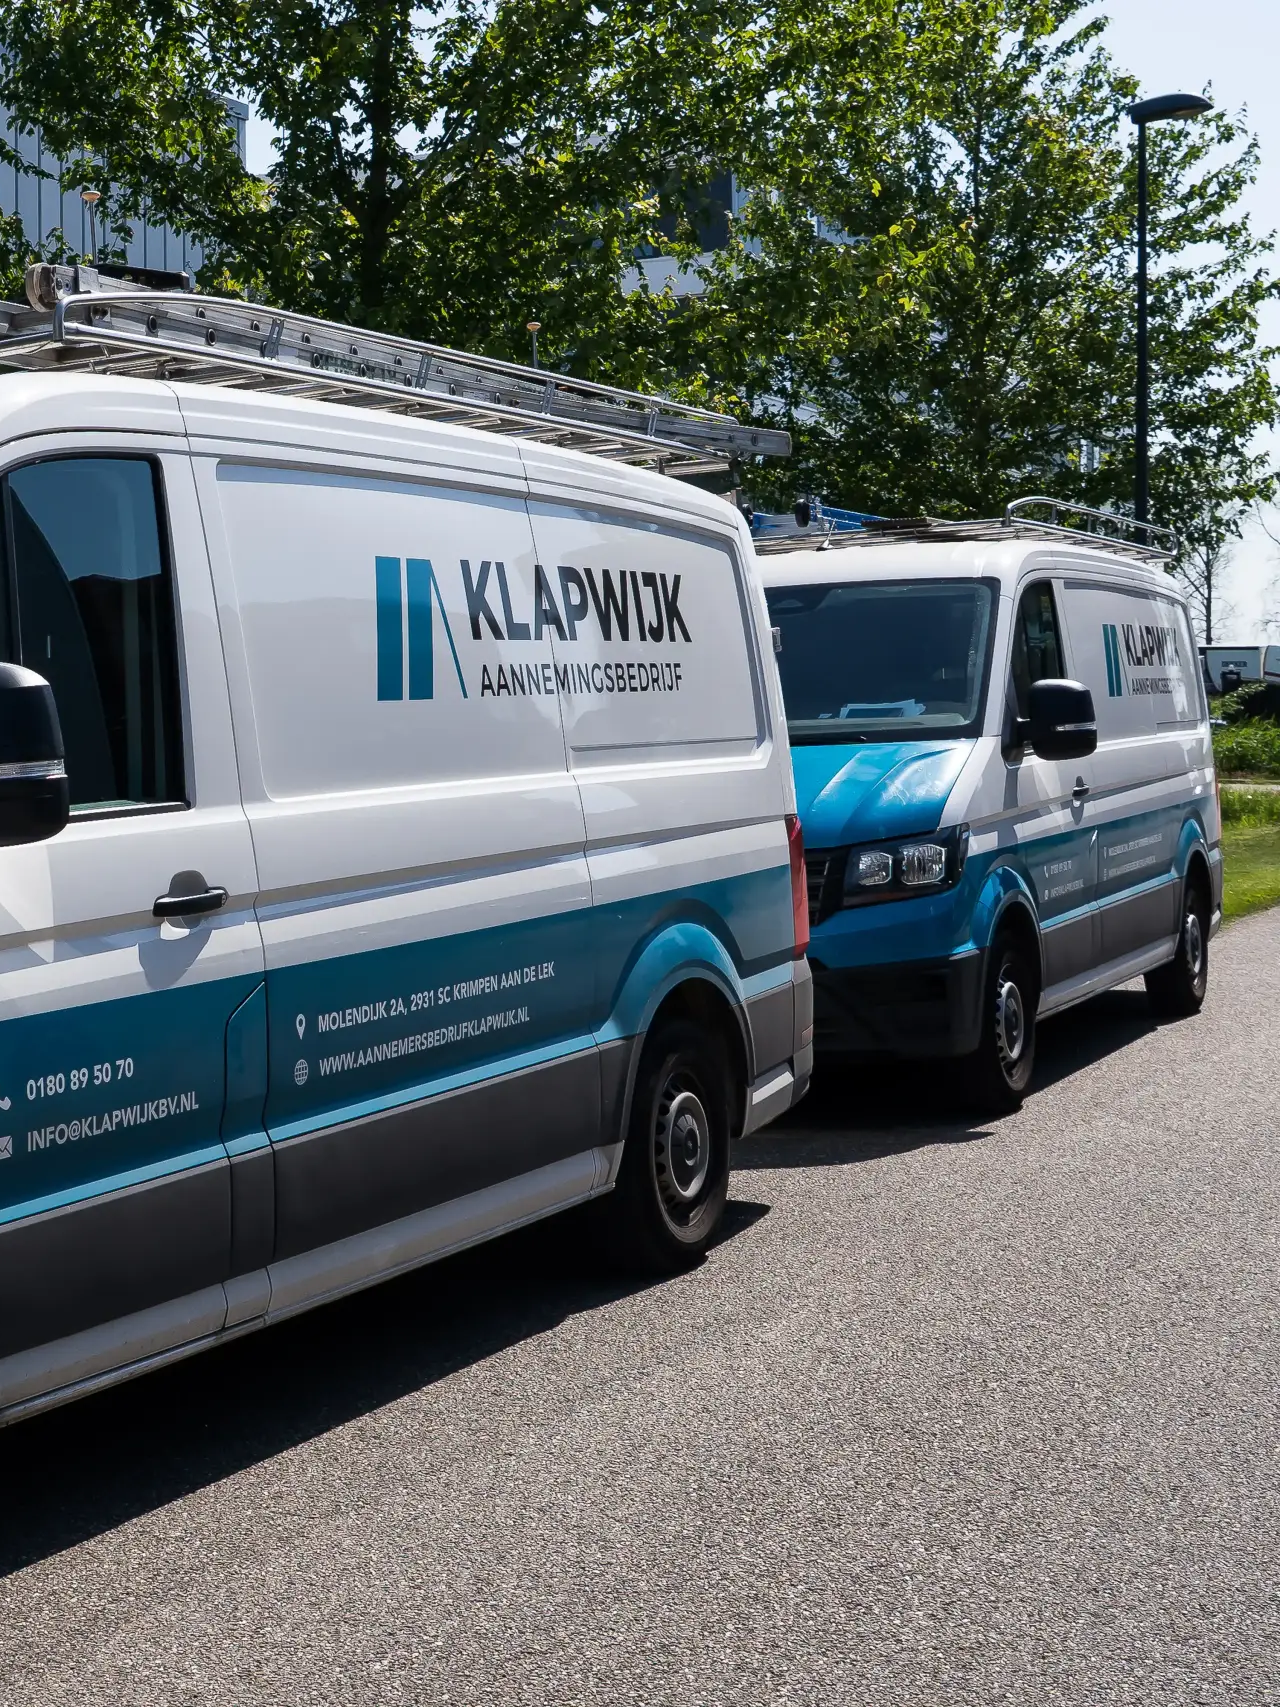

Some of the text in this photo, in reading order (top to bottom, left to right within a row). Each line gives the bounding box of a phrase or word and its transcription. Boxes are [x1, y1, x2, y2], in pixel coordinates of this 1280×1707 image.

[459, 559, 693, 643] KLAPWIJK
[480, 662, 684, 698] AANNEMINGSBEDRIJF
[318, 961, 556, 1033] MOLENDIJK 2A, 2931 SC KRIMPEN AAN DE LEK
[319, 1006, 530, 1077] WWW.AANNEMERSBEDRIJFKLAPWIJK.NL
[26, 1057, 134, 1101] 0180 89 50 70
[27, 1091, 200, 1152] INFO@KLAPWIJKBV.NL
